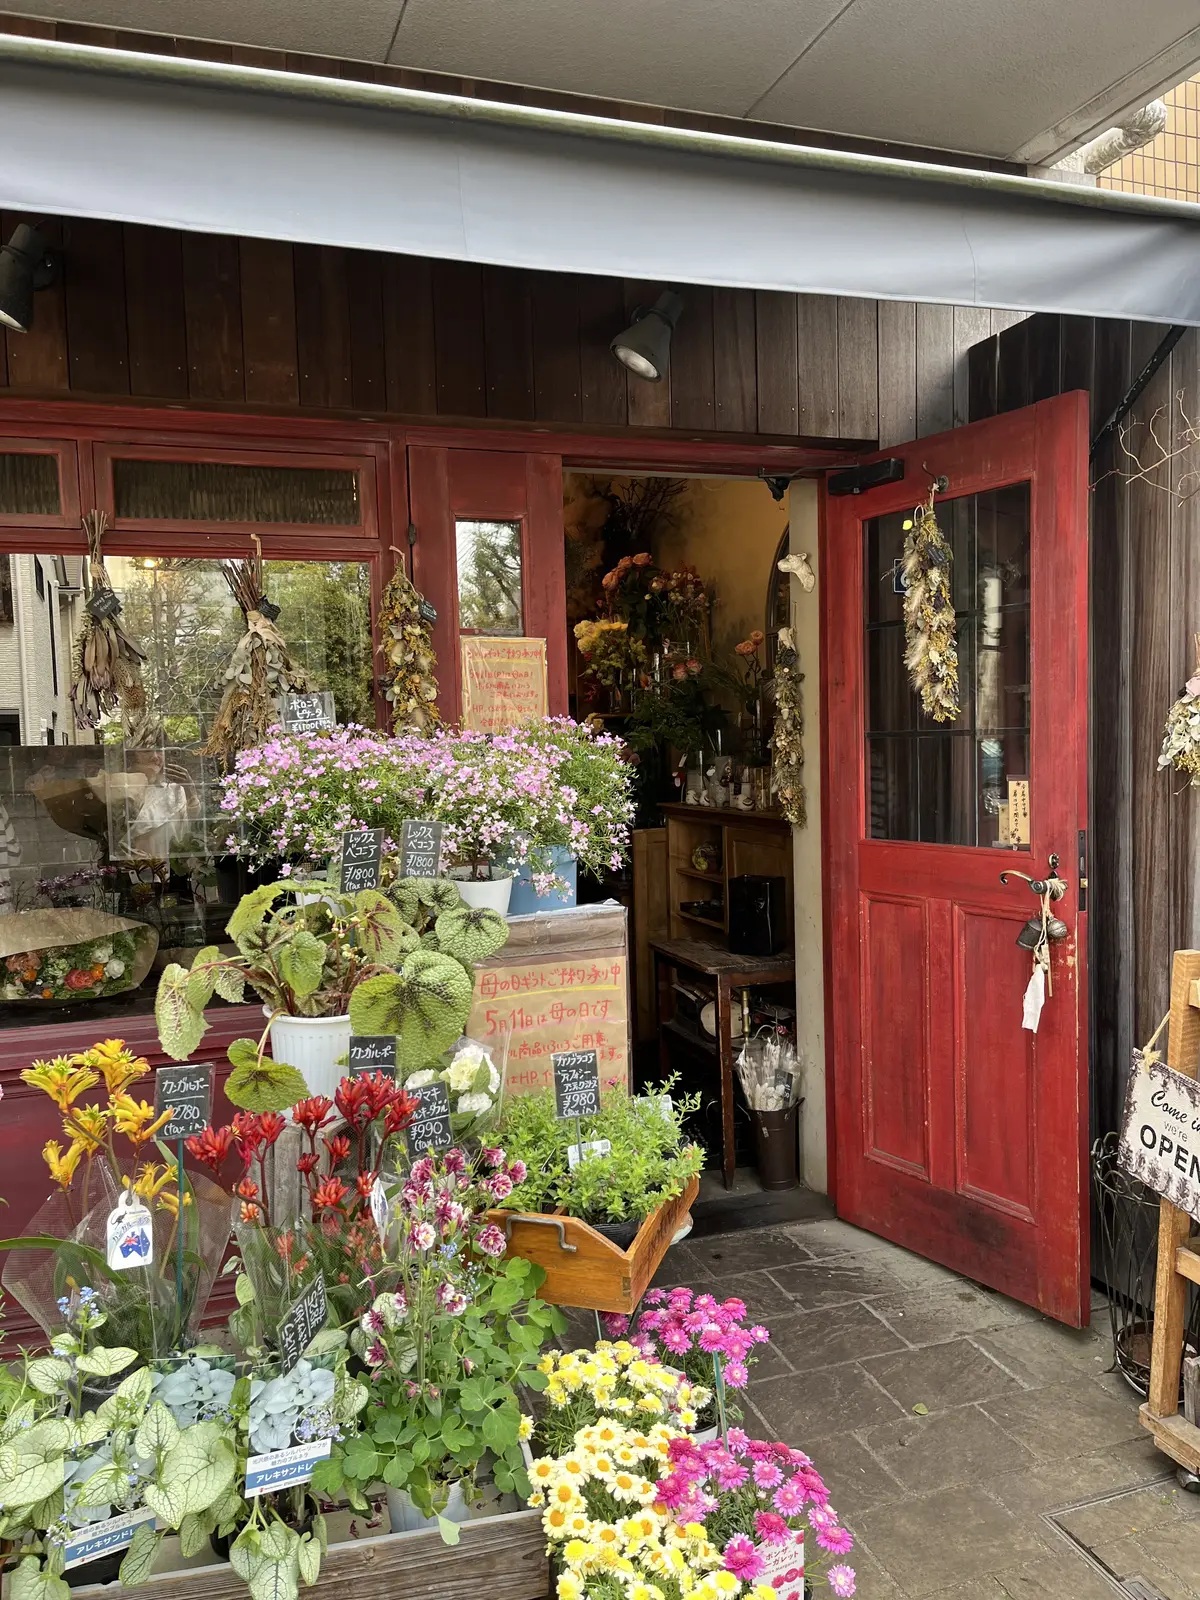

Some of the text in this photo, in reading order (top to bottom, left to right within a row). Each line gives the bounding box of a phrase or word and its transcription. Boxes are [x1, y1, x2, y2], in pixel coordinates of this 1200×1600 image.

[290, 698, 318, 710] ボロニア
[350, 832, 375, 844] レックス
[408, 824, 433, 839] レックス
[408, 839, 436, 851] ベコニア
[406, 855, 434, 868] ¥1800
[344, 866, 374, 884] ¥1800
[406, 868, 436, 876] (tax in)
[346, 878, 376, 892] (tax in)
[478, 963, 621, 999] 母の日ギフトご予約承り中
[485, 1000, 612, 1036] 5月11日は母の日です
[351, 1043, 396, 1060] カンガルーポー
[562, 1092, 596, 1110] ¥980
[582, 1104, 598, 1114] in)
[1150, 1089, 1188, 1124] Come
[164, 1118, 208, 1136] (tax in)
[410, 1122, 443, 1140] ¥990
[1162, 1120, 1188, 1143] we're
[414, 1132, 451, 1152] (tax in)
[1139, 1124, 1200, 1184] OPEN
[256, 1460, 318, 1484] アレキサンドレ
[76, 1508, 150, 1536] 沢感のあるシルバーリーフ
[764, 1550, 800, 1568] ーガレット
